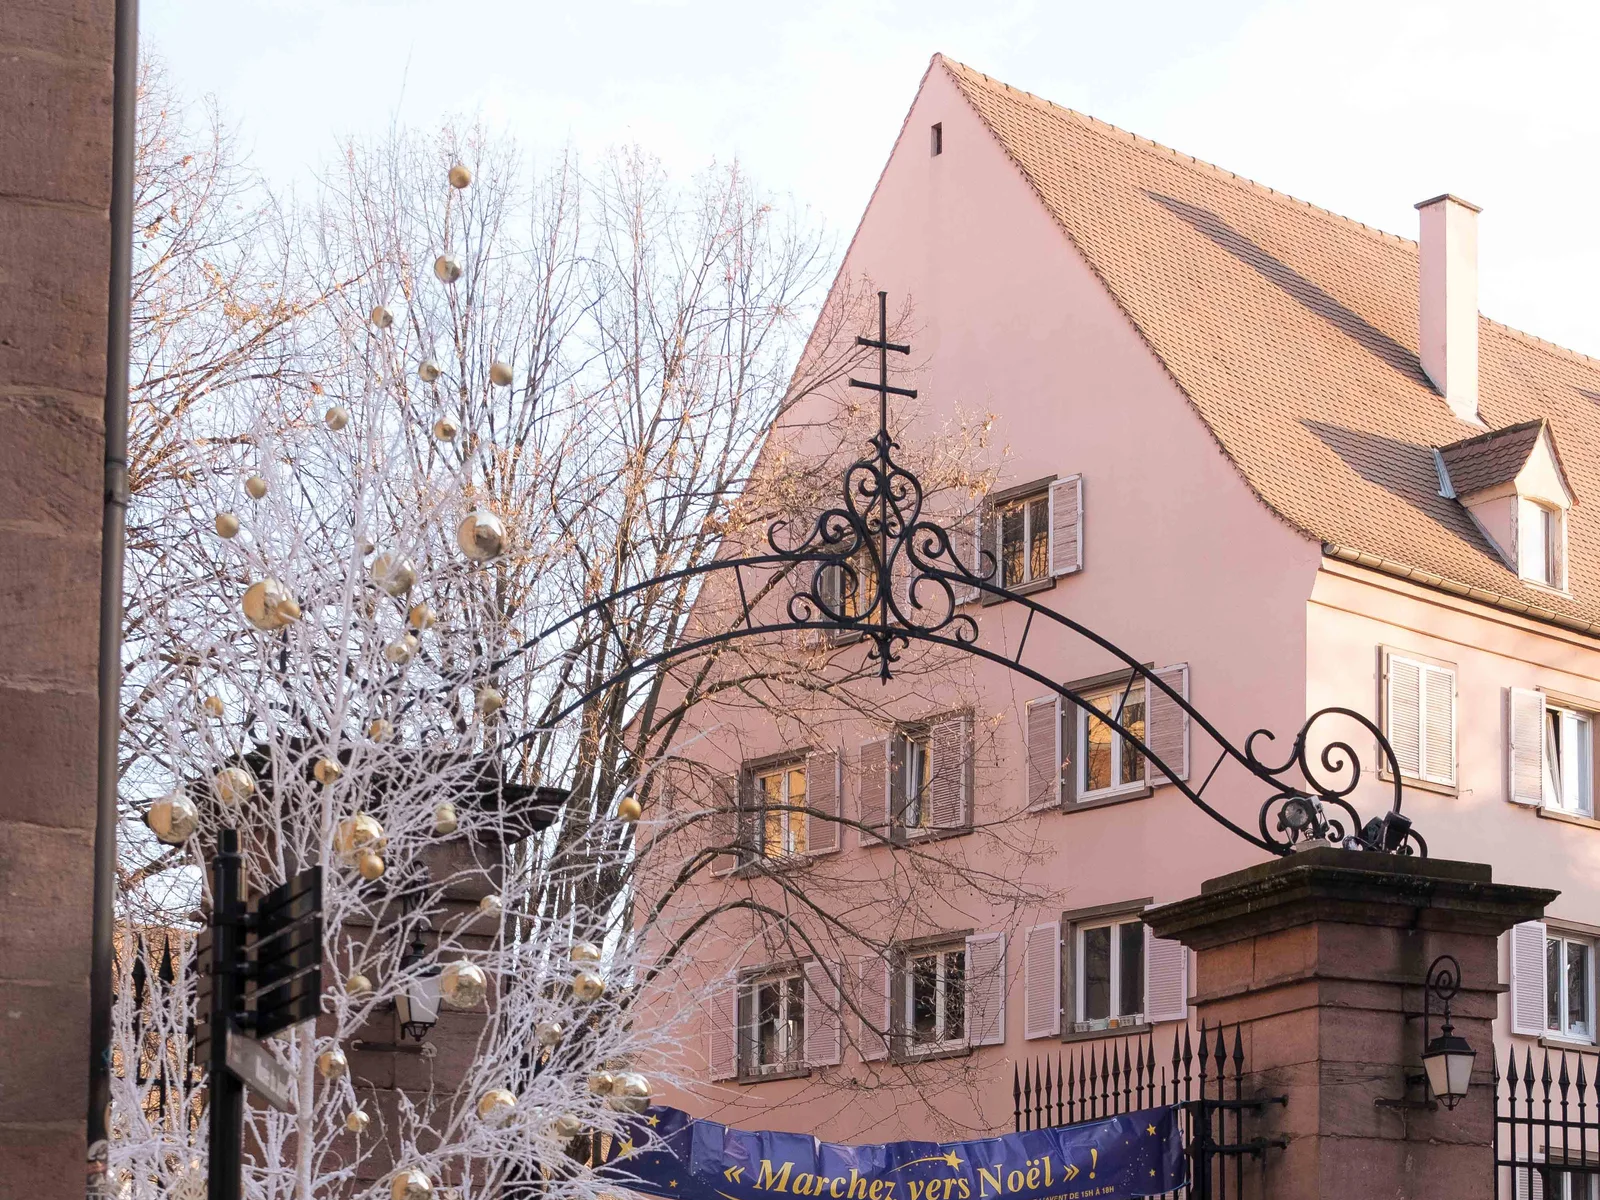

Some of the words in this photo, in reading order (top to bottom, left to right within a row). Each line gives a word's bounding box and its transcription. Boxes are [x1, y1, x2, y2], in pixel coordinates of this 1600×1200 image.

[977, 1156, 1055, 1197] Noël
[1089, 1148, 1098, 1180] !
[1069, 1192, 1080, 1200] DE
[1081, 1190, 1094, 1198] 15H
